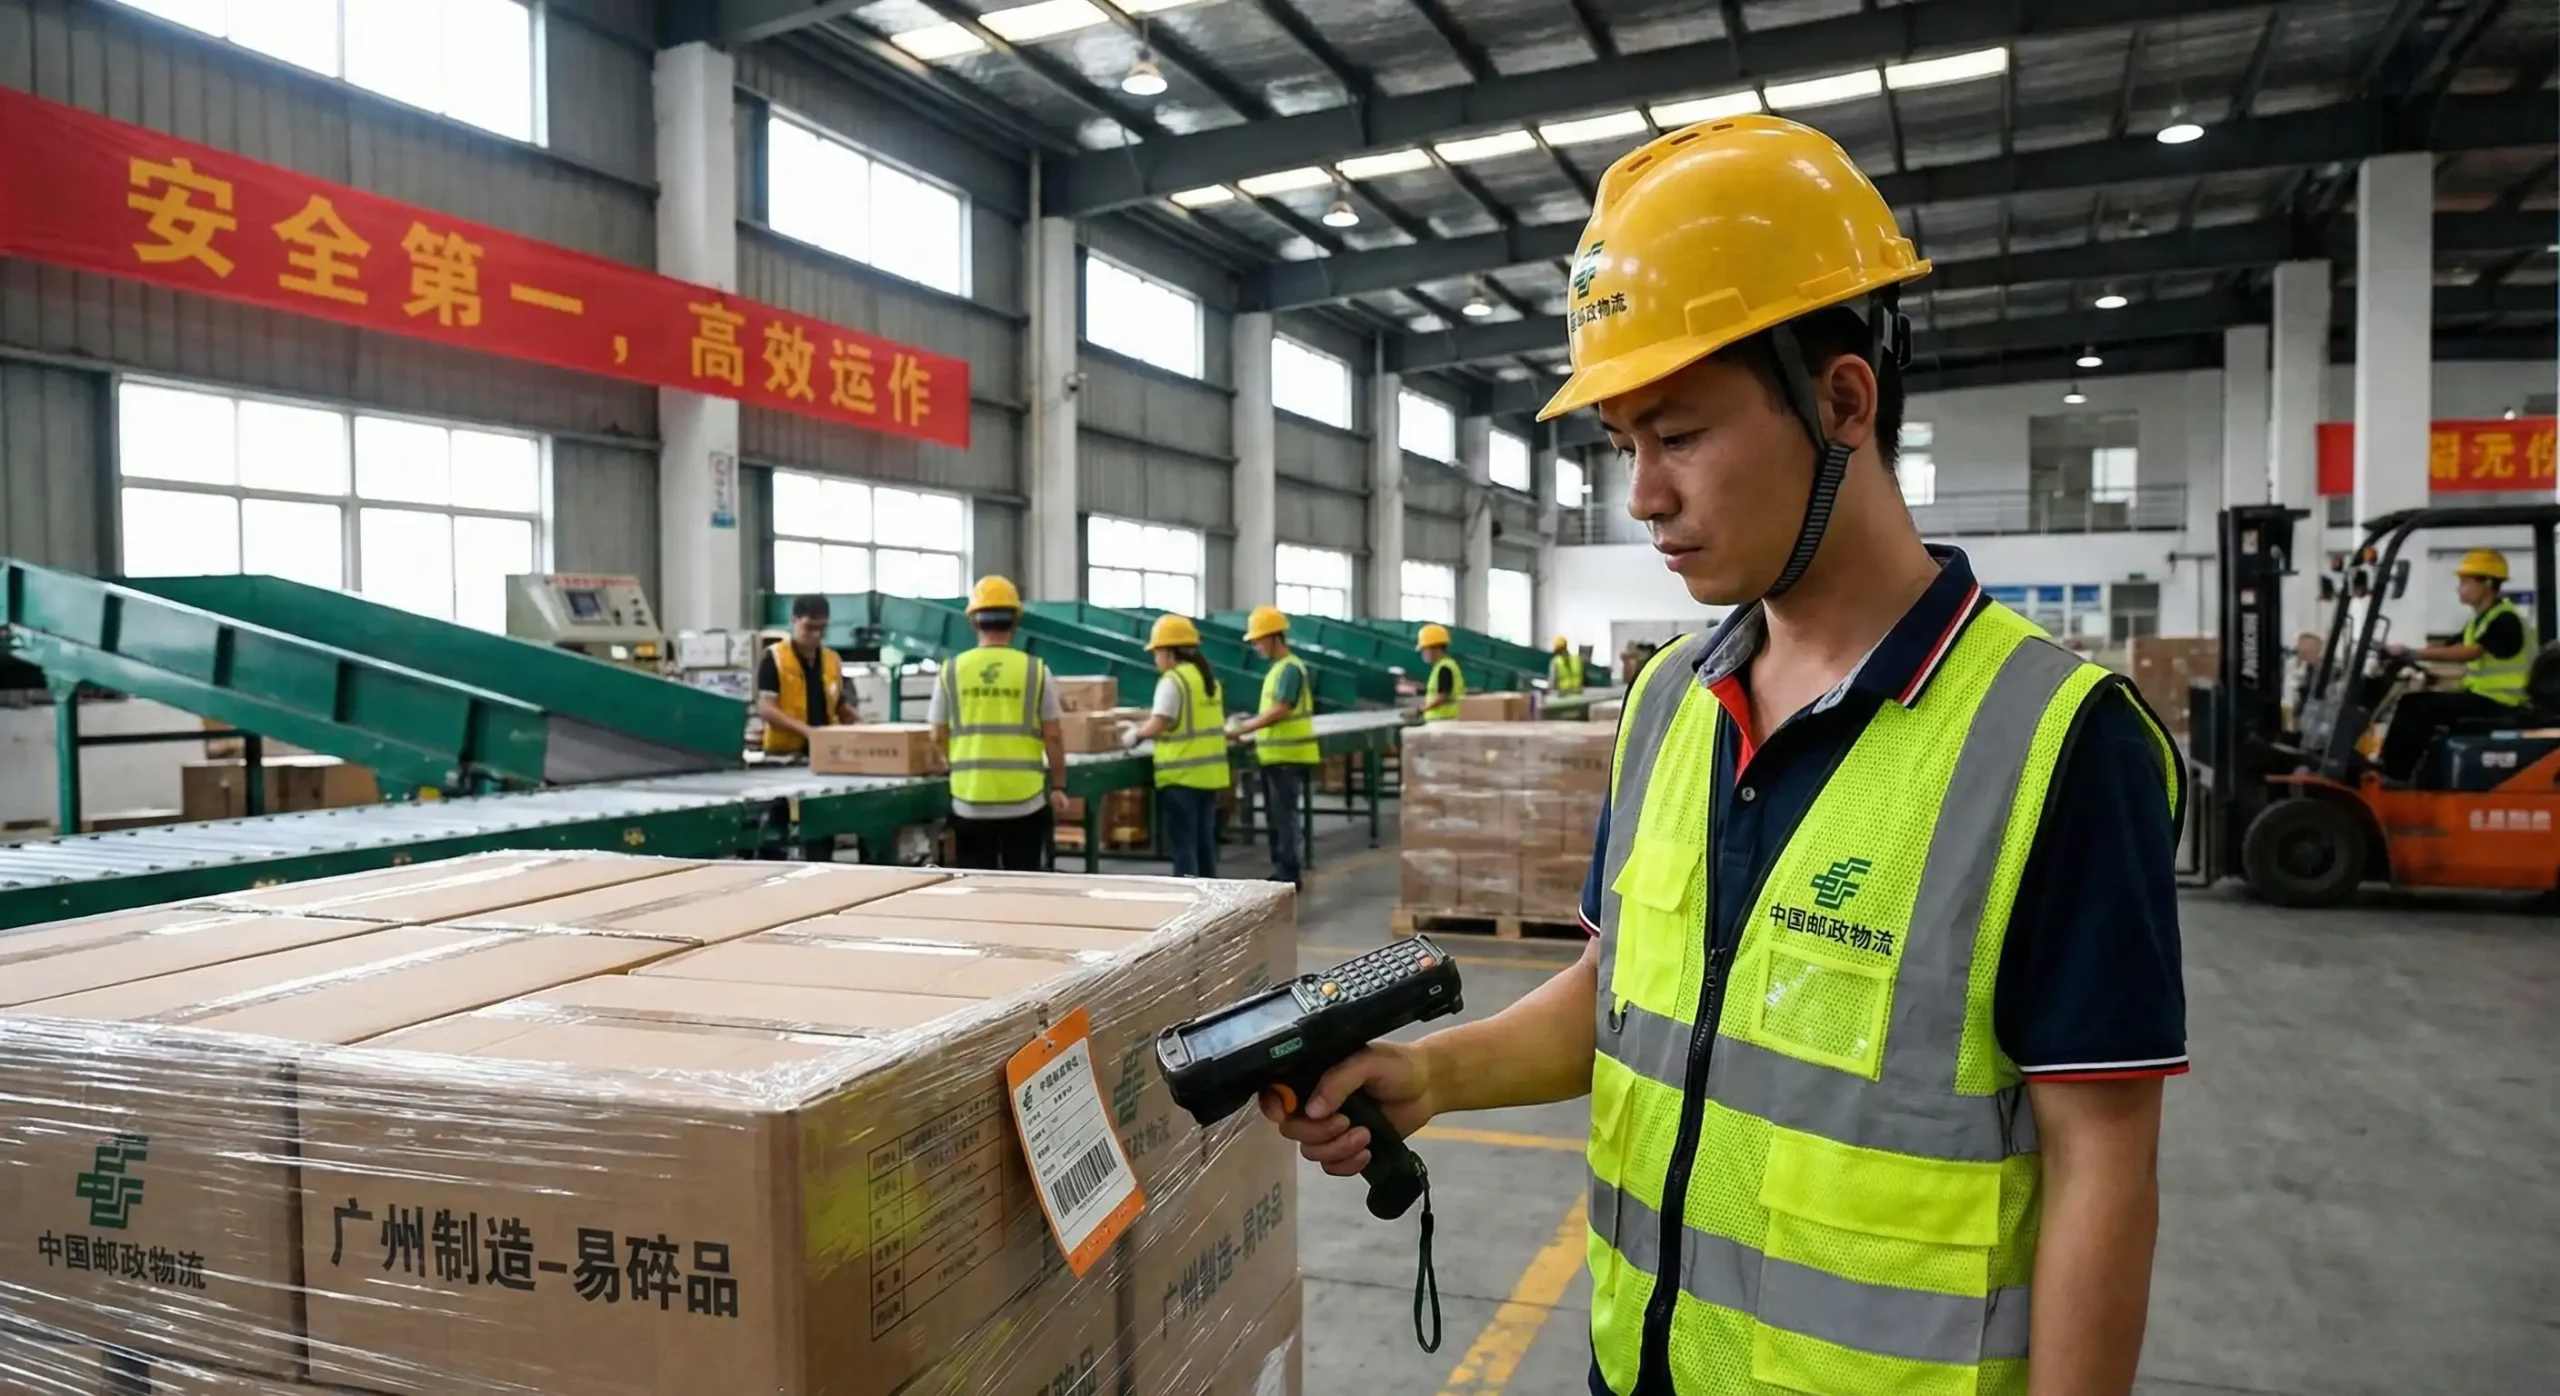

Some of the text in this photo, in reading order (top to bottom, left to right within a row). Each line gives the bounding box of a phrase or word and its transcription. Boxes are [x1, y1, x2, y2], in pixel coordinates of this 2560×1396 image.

[1769, 902, 1895, 957] 中国邮政物流
[37, 1228, 207, 1291] 中国邮政物流
